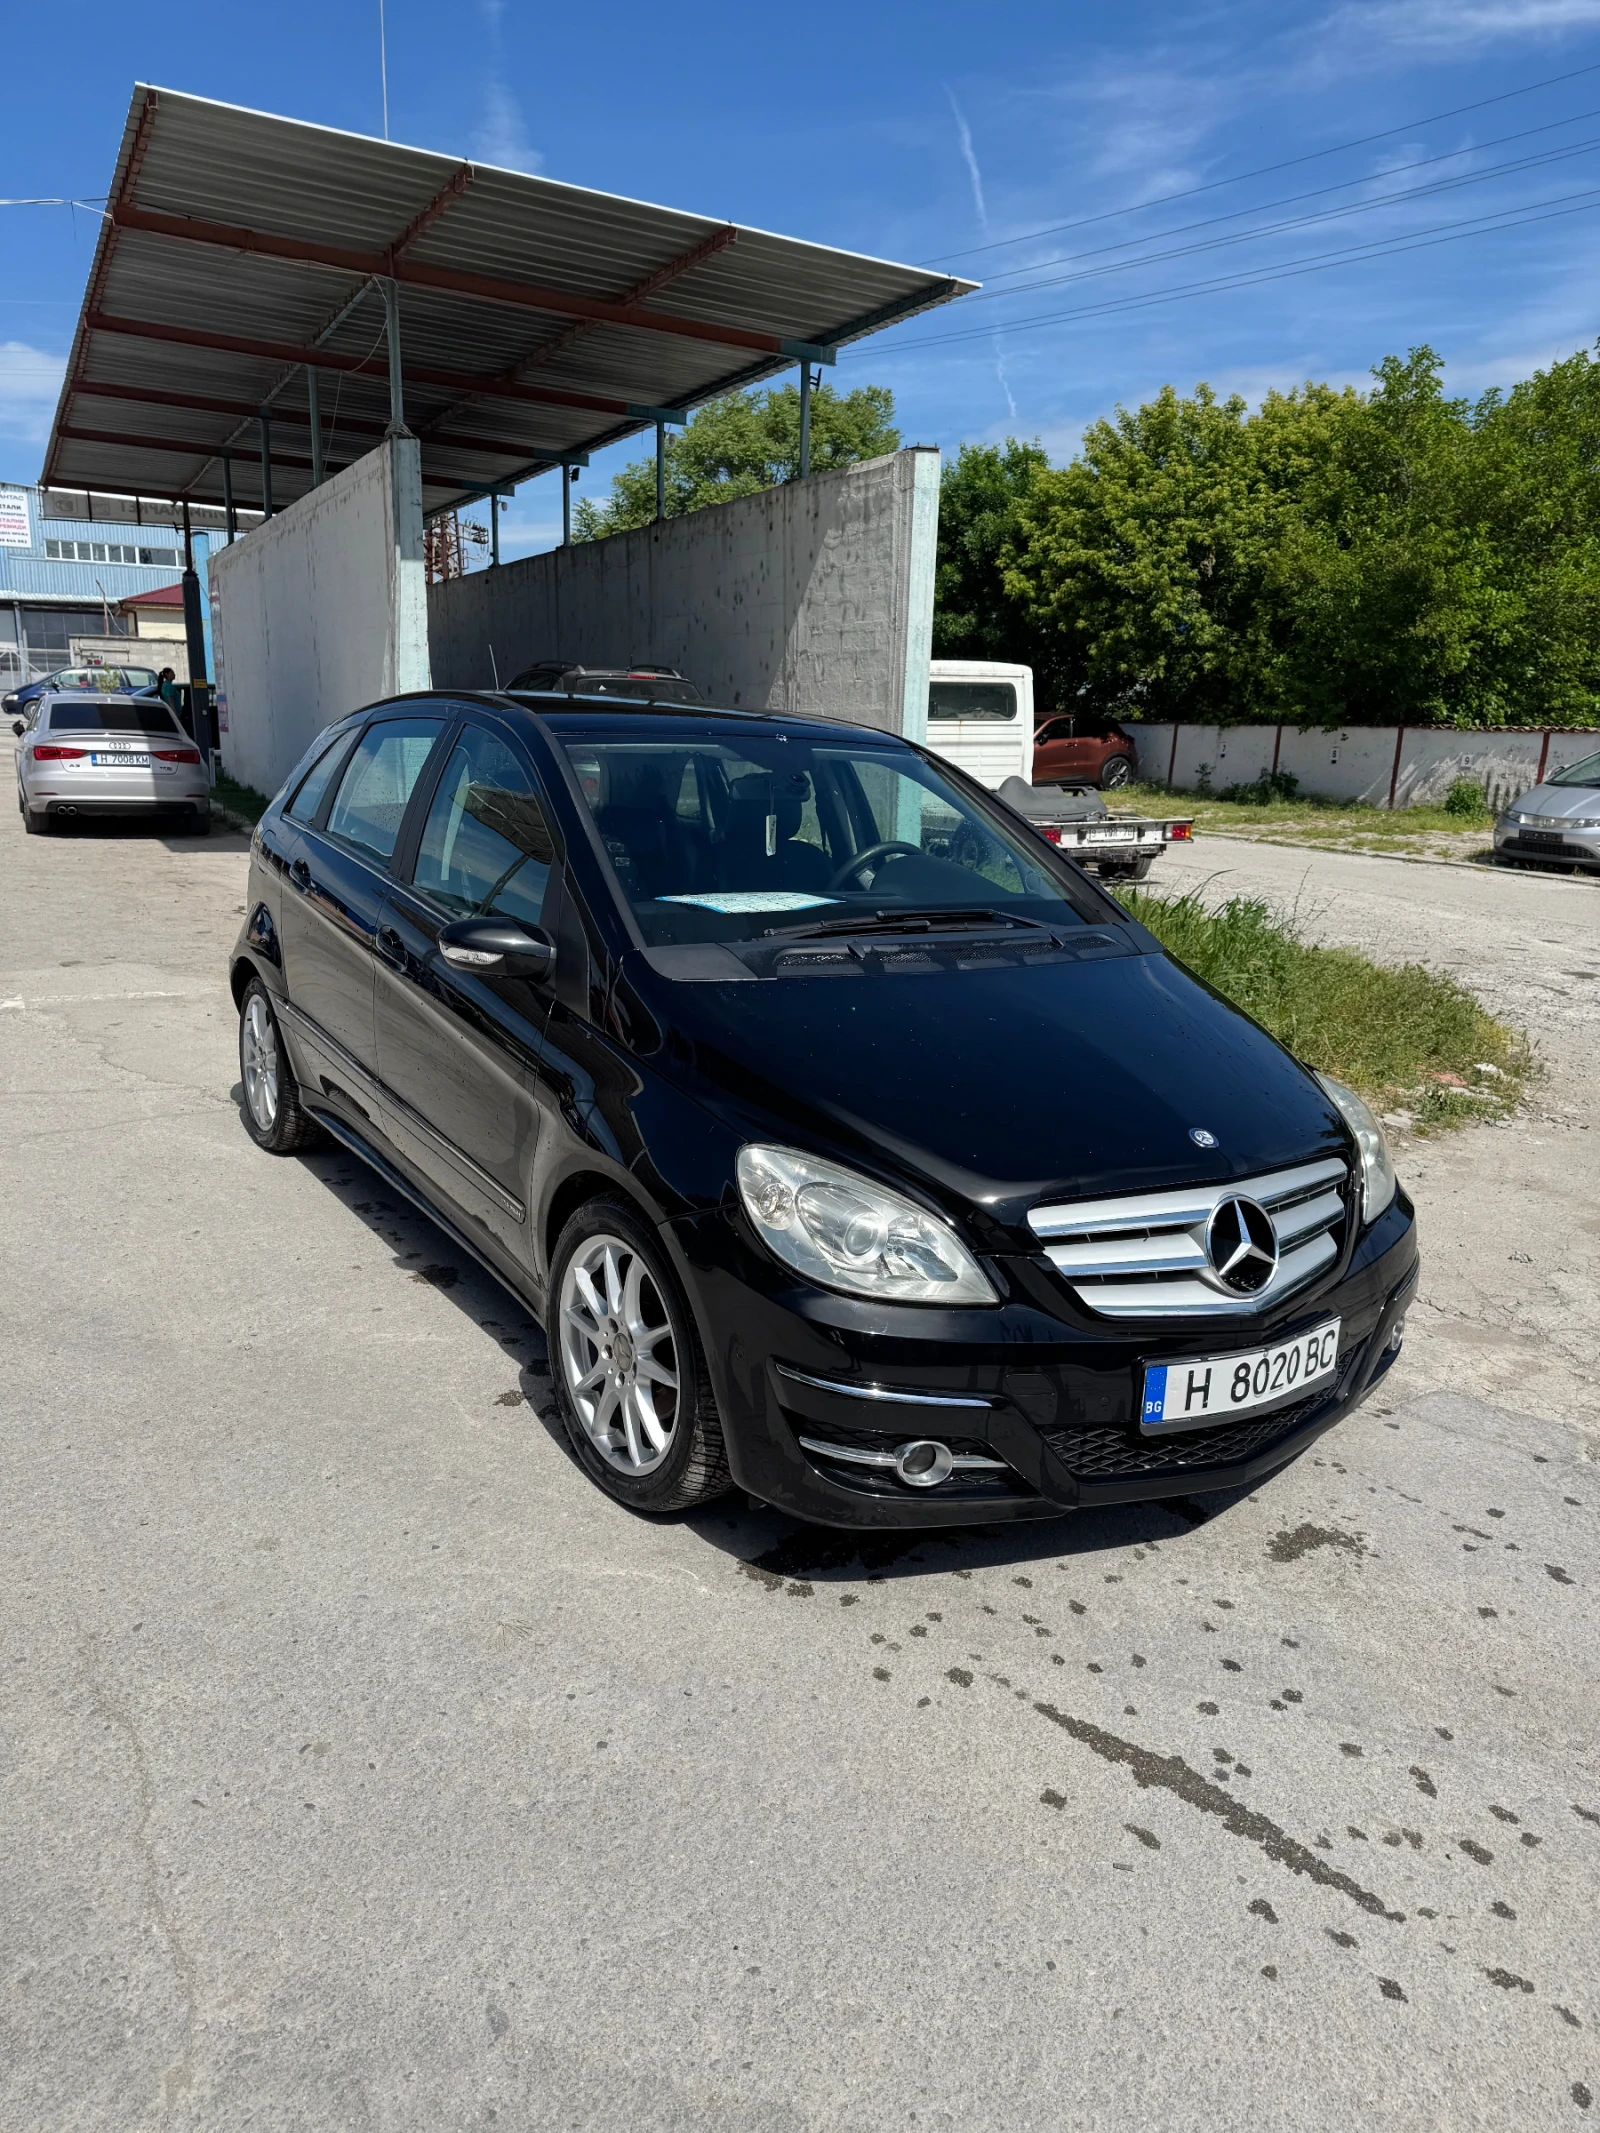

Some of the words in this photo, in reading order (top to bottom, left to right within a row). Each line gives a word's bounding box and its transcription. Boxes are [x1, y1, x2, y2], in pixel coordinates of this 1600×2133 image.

[1464, 756, 1470, 765] 9
[1184, 1367, 1212, 1411] H
[1145, 1401, 1162, 1413] BG
